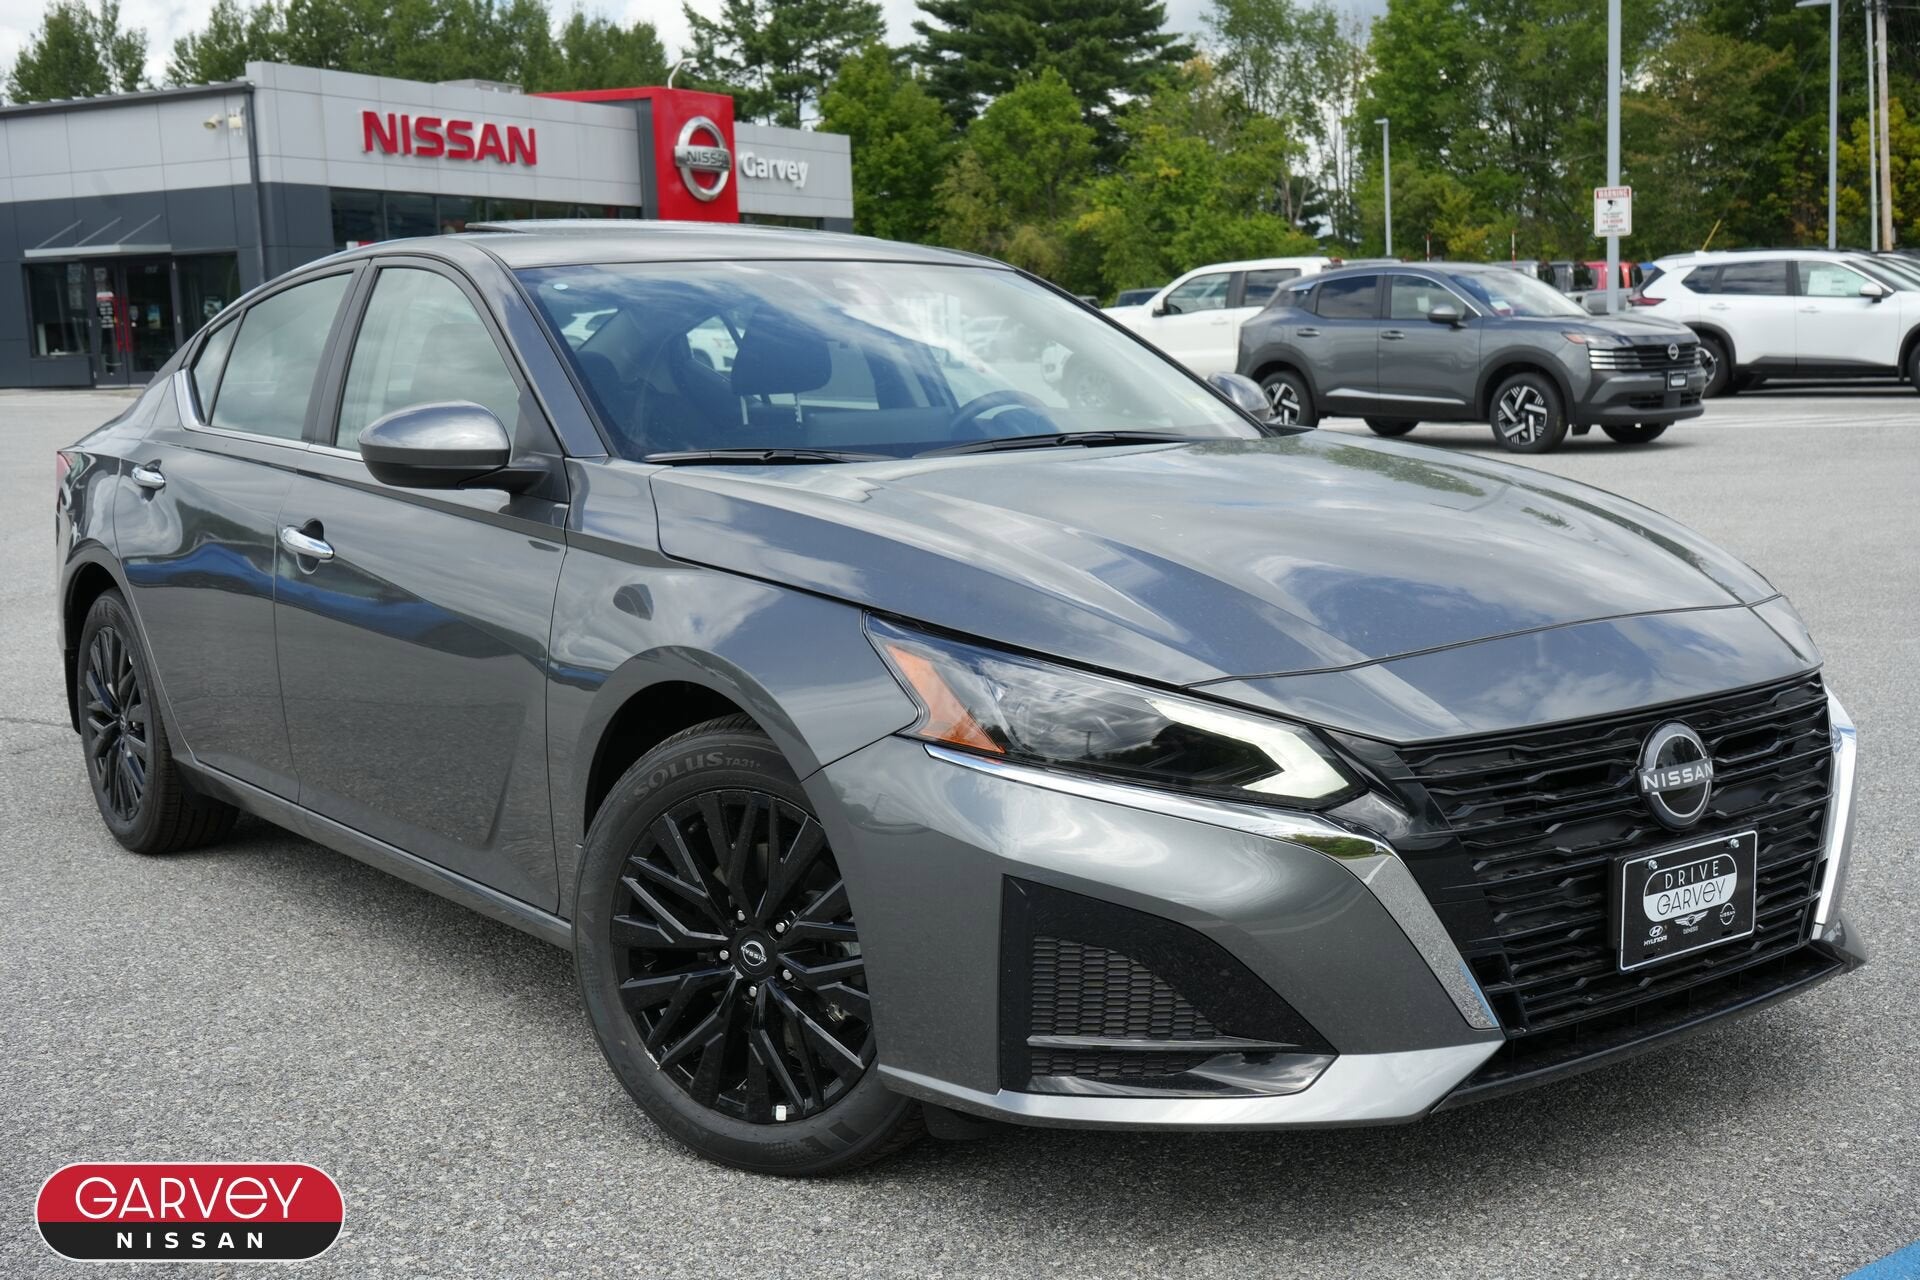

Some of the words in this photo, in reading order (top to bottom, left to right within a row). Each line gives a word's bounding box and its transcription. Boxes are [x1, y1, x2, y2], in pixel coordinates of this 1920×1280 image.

[362, 110, 537, 166] NISSAN
[742, 152, 809, 188] Garvey
[633, 752, 724, 797] SOLUS
[1643, 762, 1714, 790] NISSAN
[1665, 860, 1719, 889] DRIVE
[1643, 935, 1668, 946] HYUNDAI
